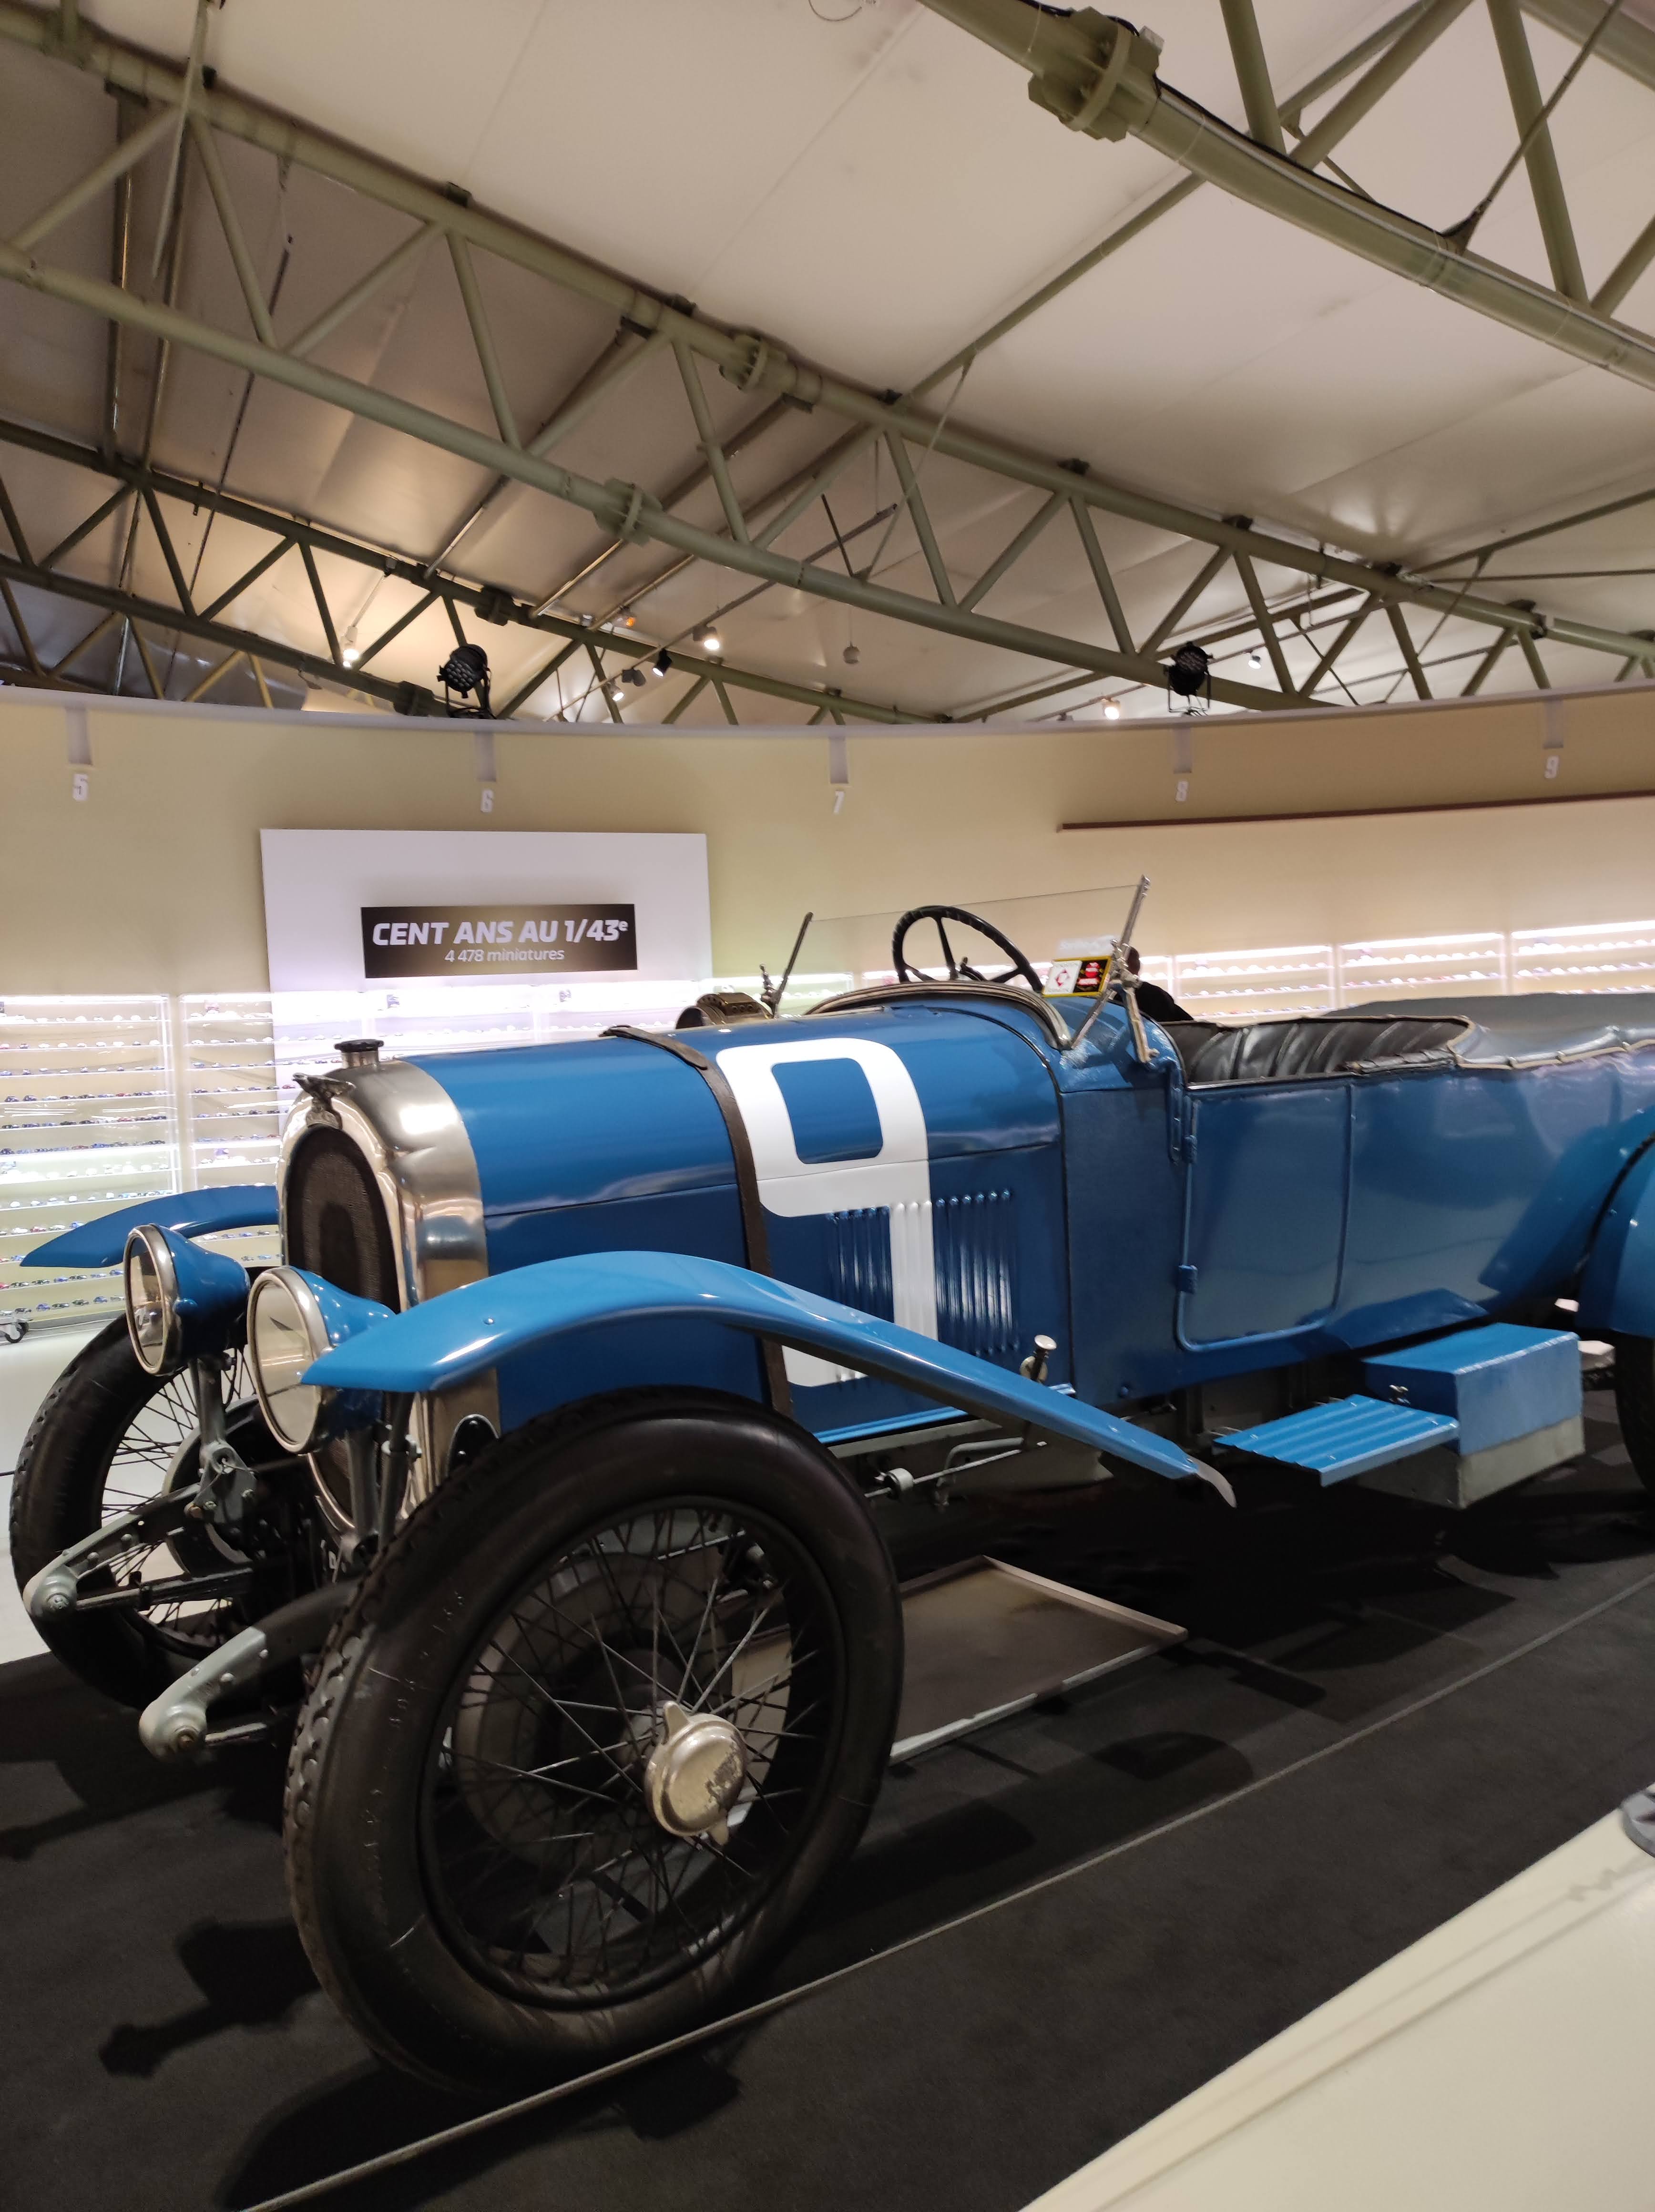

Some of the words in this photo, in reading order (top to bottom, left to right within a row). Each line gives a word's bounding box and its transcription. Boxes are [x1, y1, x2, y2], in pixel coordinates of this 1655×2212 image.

[833, 791, 844, 813] 7
[372, 922, 449, 945] CENT
[453, 921, 514, 944] ANS
[518, 921, 558, 942] AU
[444, 950, 454, 963] 4
[457, 950, 484, 962] 478
[487, 948, 565, 961] miniatures
